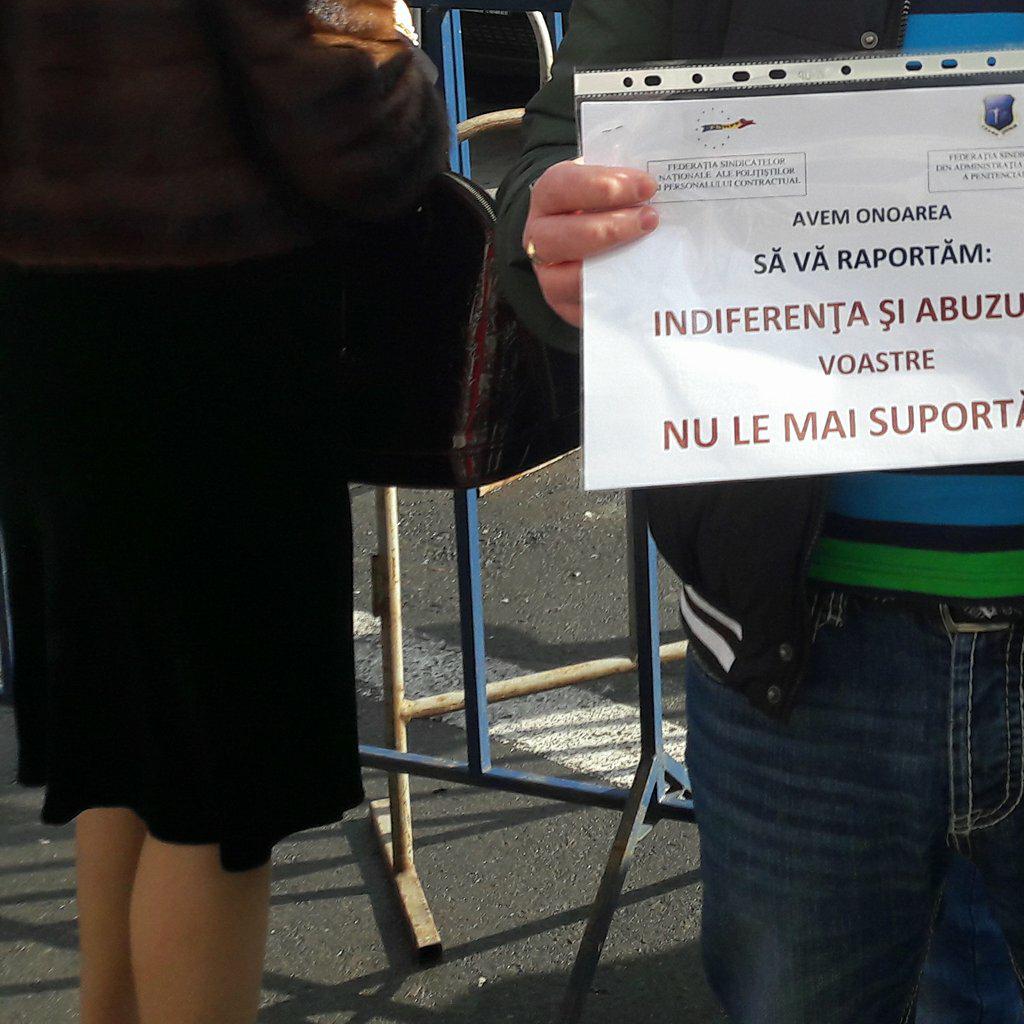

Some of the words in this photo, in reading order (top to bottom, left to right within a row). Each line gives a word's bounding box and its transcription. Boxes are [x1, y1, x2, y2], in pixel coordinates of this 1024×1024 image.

[716, 170, 731, 178] ALE
[720, 157, 786, 168] SINDICATELOR
[734, 176, 801, 187] CONTRACTUAL
[792, 208, 850, 227] AVEM
[855, 204, 953, 225] ONOAREA
[753, 246, 787, 275] SĂ
[792, 244, 830, 273] VĂ
[837, 238, 993, 271] RAPORTĂM:
[817, 348, 936, 376] VOASTRE
[663, 417, 719, 451] NU
[733, 414, 771, 446] LE
[783, 408, 857, 443] MAI
